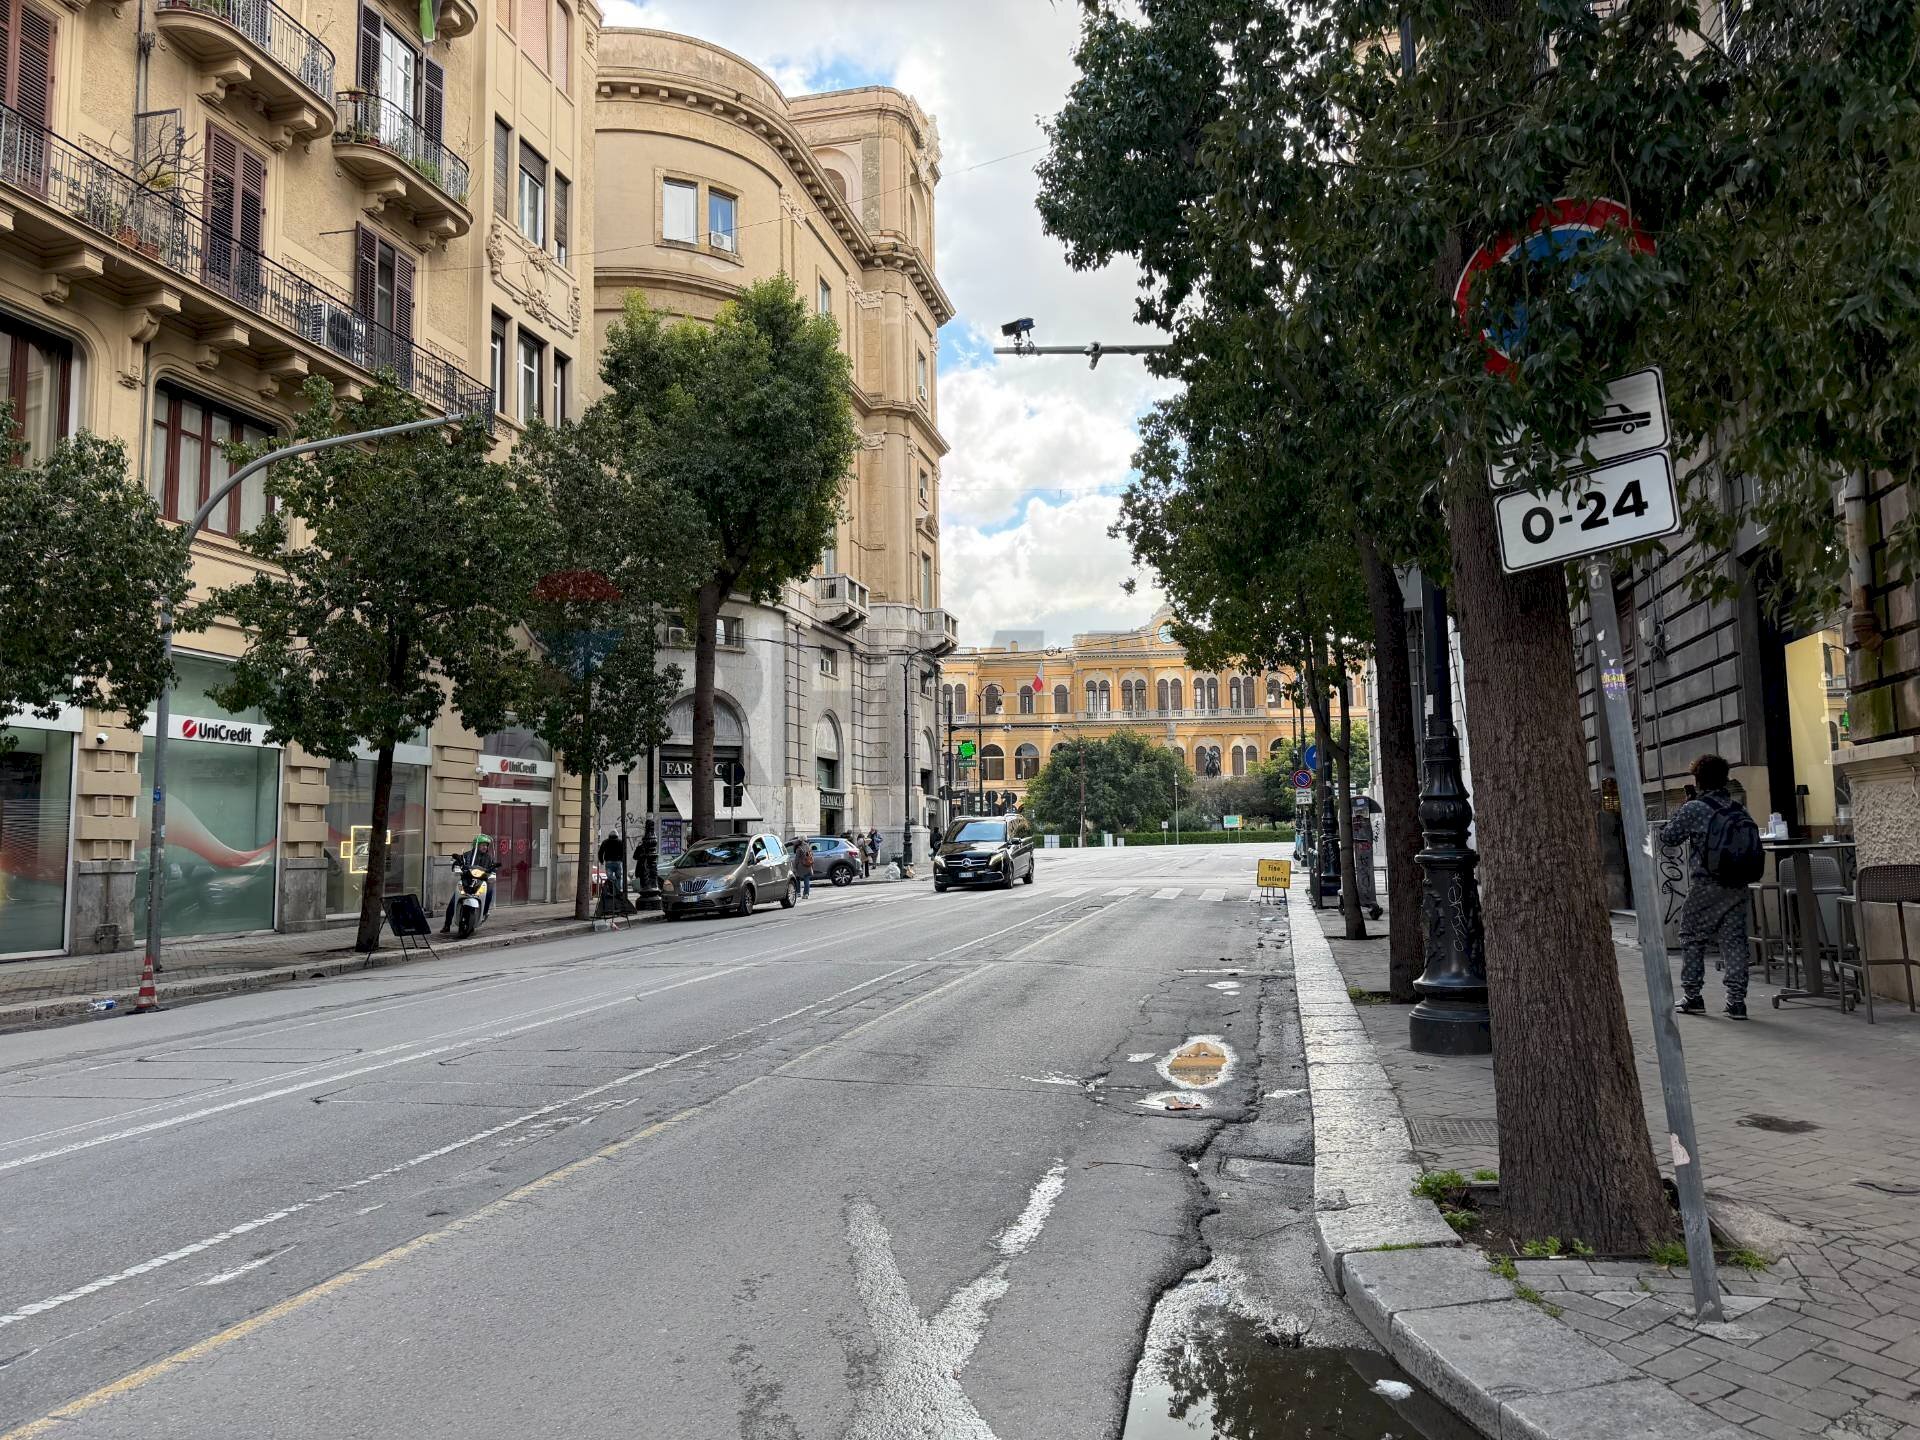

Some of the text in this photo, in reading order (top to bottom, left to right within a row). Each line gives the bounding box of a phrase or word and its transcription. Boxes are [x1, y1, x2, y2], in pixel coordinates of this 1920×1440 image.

[1521, 479, 1649, 545] 0-24
[199, 723, 252, 743] UniCredit
[509, 761, 537, 774] UniCredit
[665, 762, 724, 775] FARC
